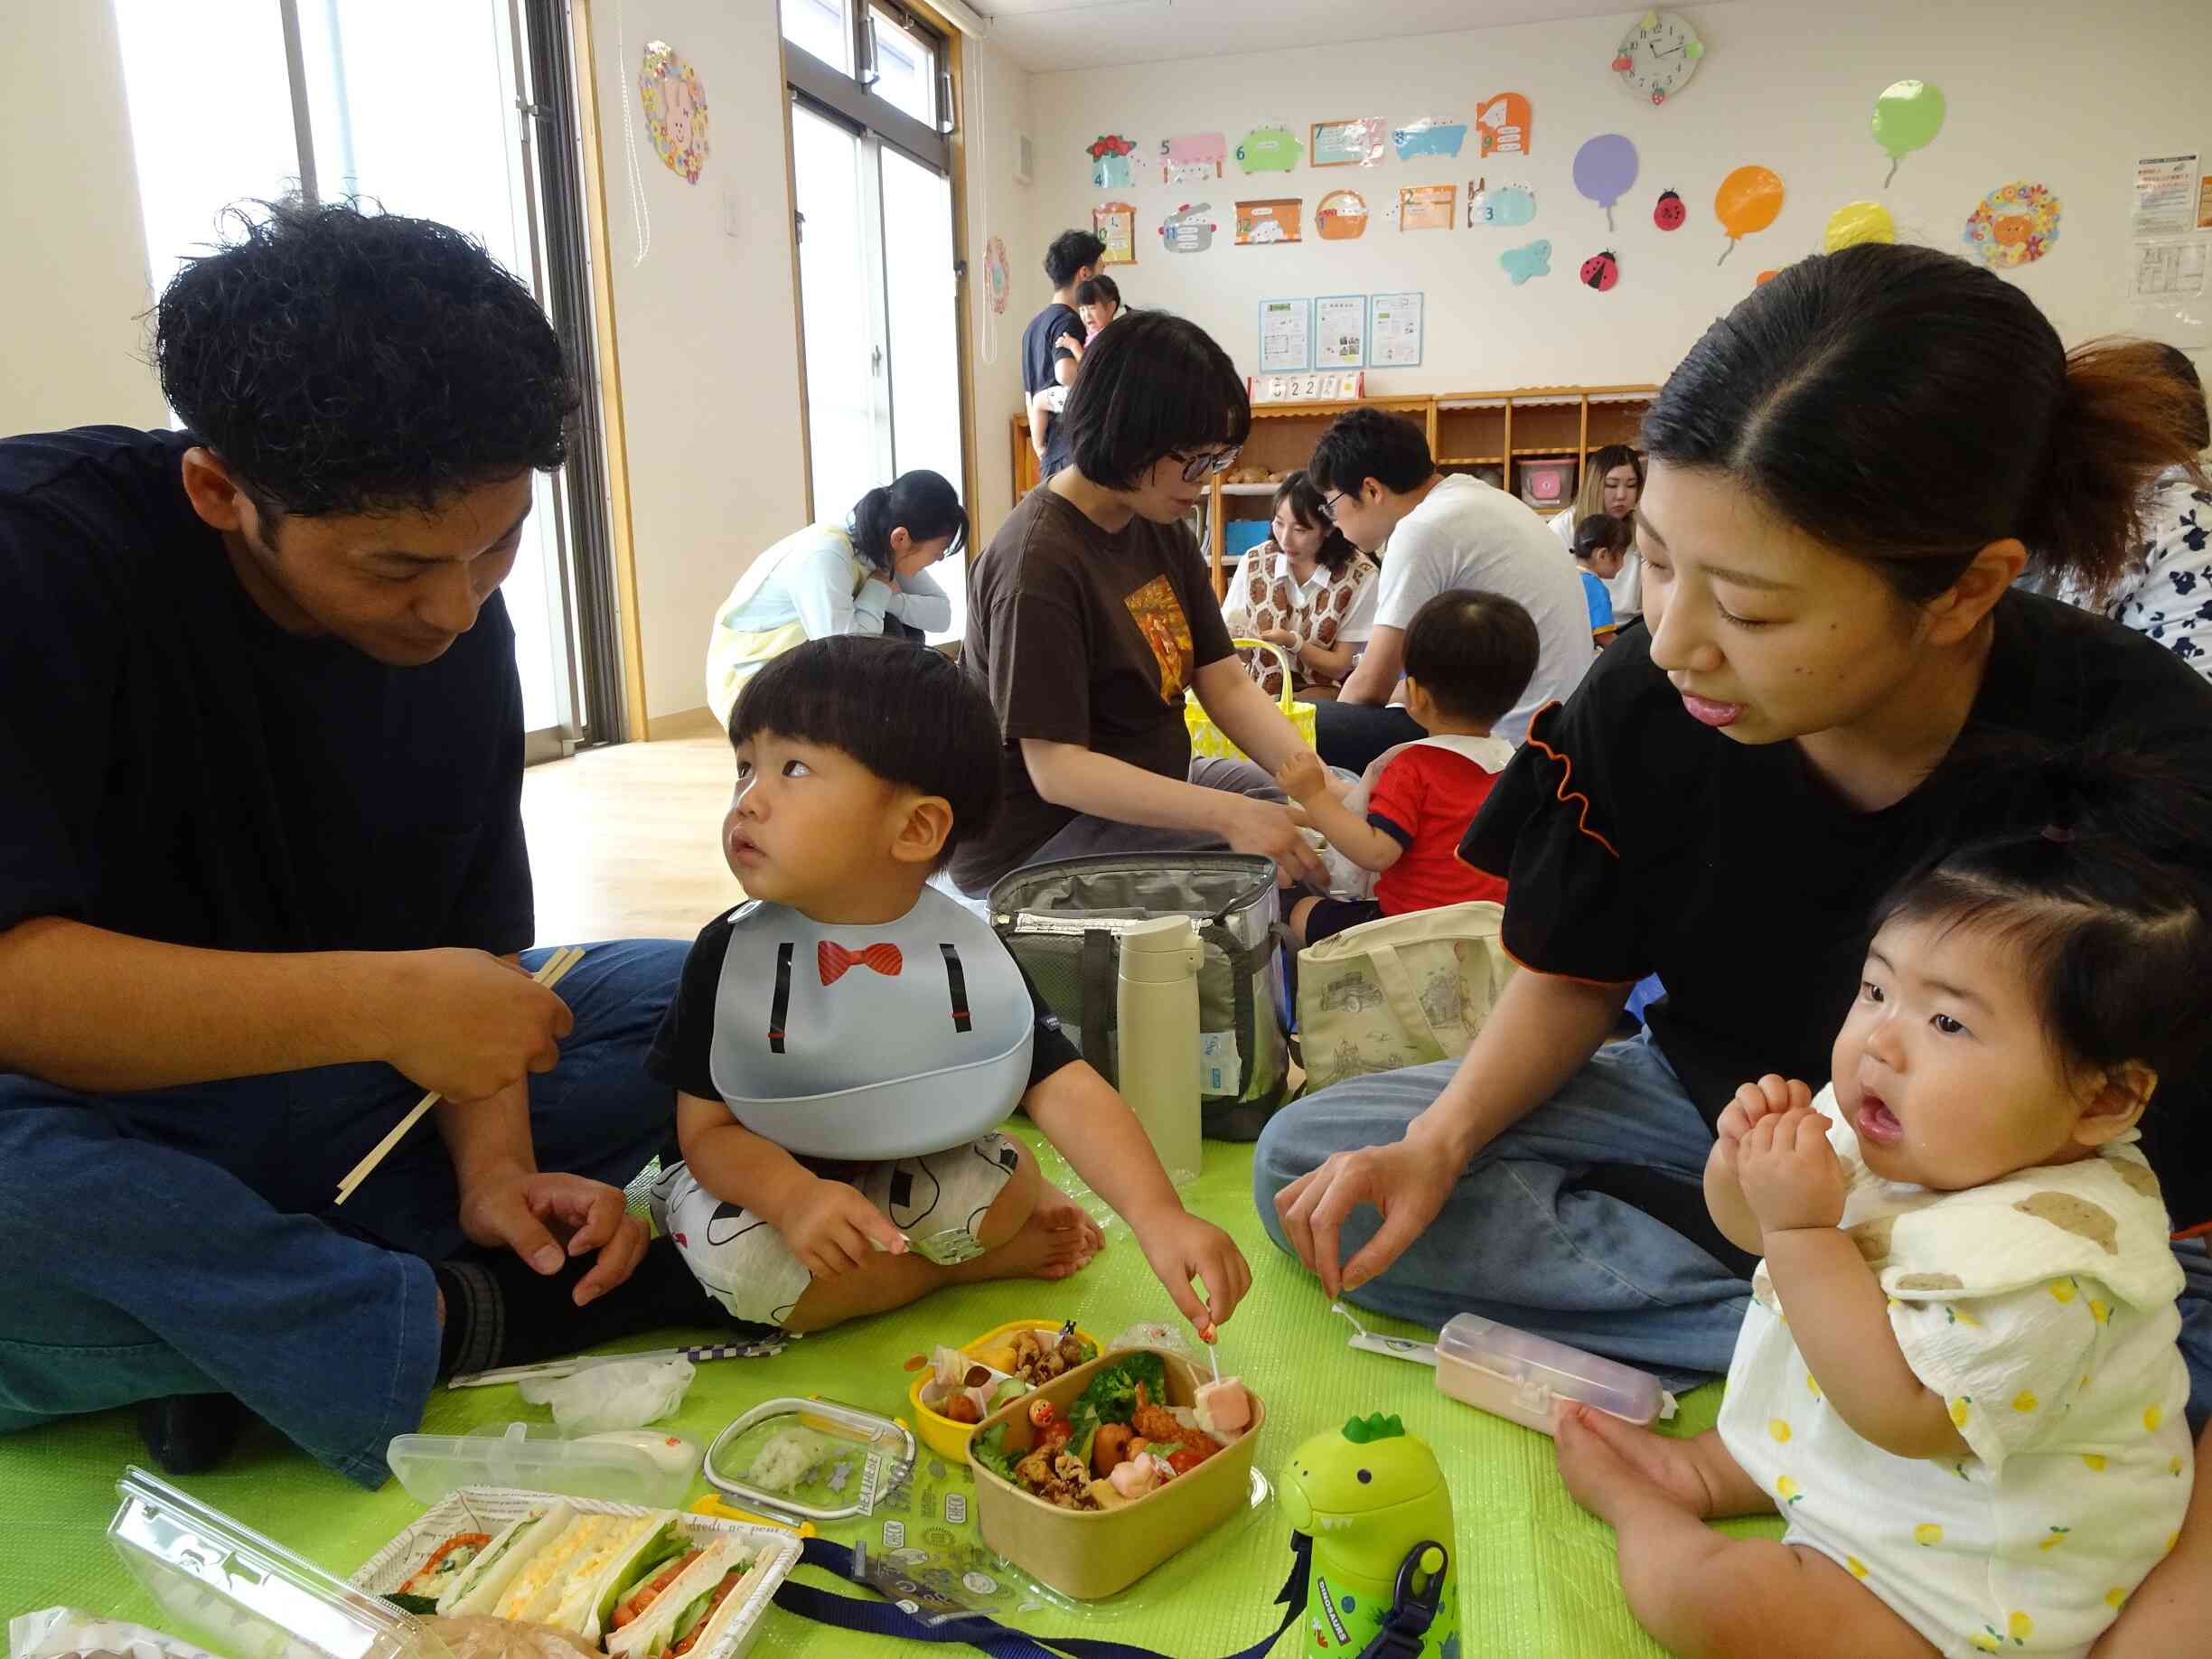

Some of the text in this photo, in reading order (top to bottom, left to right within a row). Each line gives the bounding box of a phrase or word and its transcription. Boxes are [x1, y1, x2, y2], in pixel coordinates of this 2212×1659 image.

[1161, 140, 1171, 155] 5
[1236, 145, 1245, 161] 6
[1093, 173, 1103, 189] 4
[1403, 188, 1414, 204] 2
[1485, 206, 1494, 220] 3
[1166, 227, 1177, 239] 11
[1292, 382, 1299, 396] 2
[1306, 381, 1314, 395] 2
[1319, 1581, 1346, 1641] DINOSAURS
